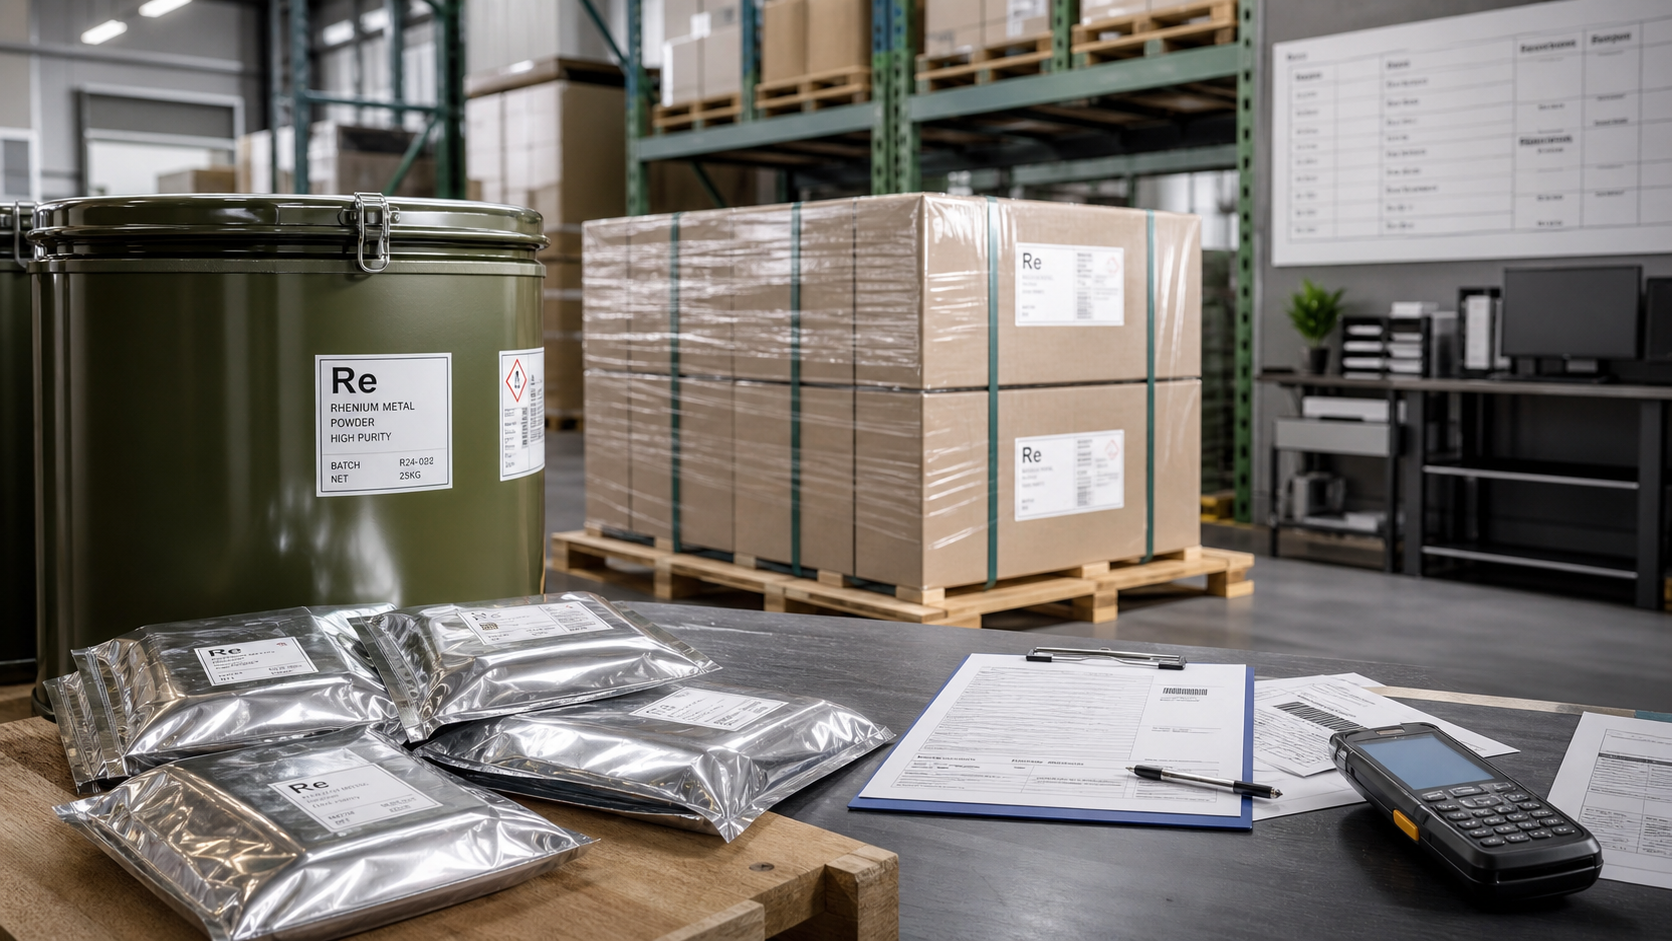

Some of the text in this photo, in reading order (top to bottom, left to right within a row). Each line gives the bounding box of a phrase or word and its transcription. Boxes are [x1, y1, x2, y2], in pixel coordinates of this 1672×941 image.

[1022, 252, 1042, 270] Re
[332, 367, 377, 394] Re
[331, 401, 415, 413] RHENIUM METAL
[331, 418, 375, 428] POWDER
[331, 432, 391, 443] HIGH PURITY
[1022, 446, 1042, 464] Re
[331, 461, 361, 470] BATCH
[331, 474, 349, 484] NET
[208, 648, 242, 657] Re
[288, 780, 330, 795] Re
